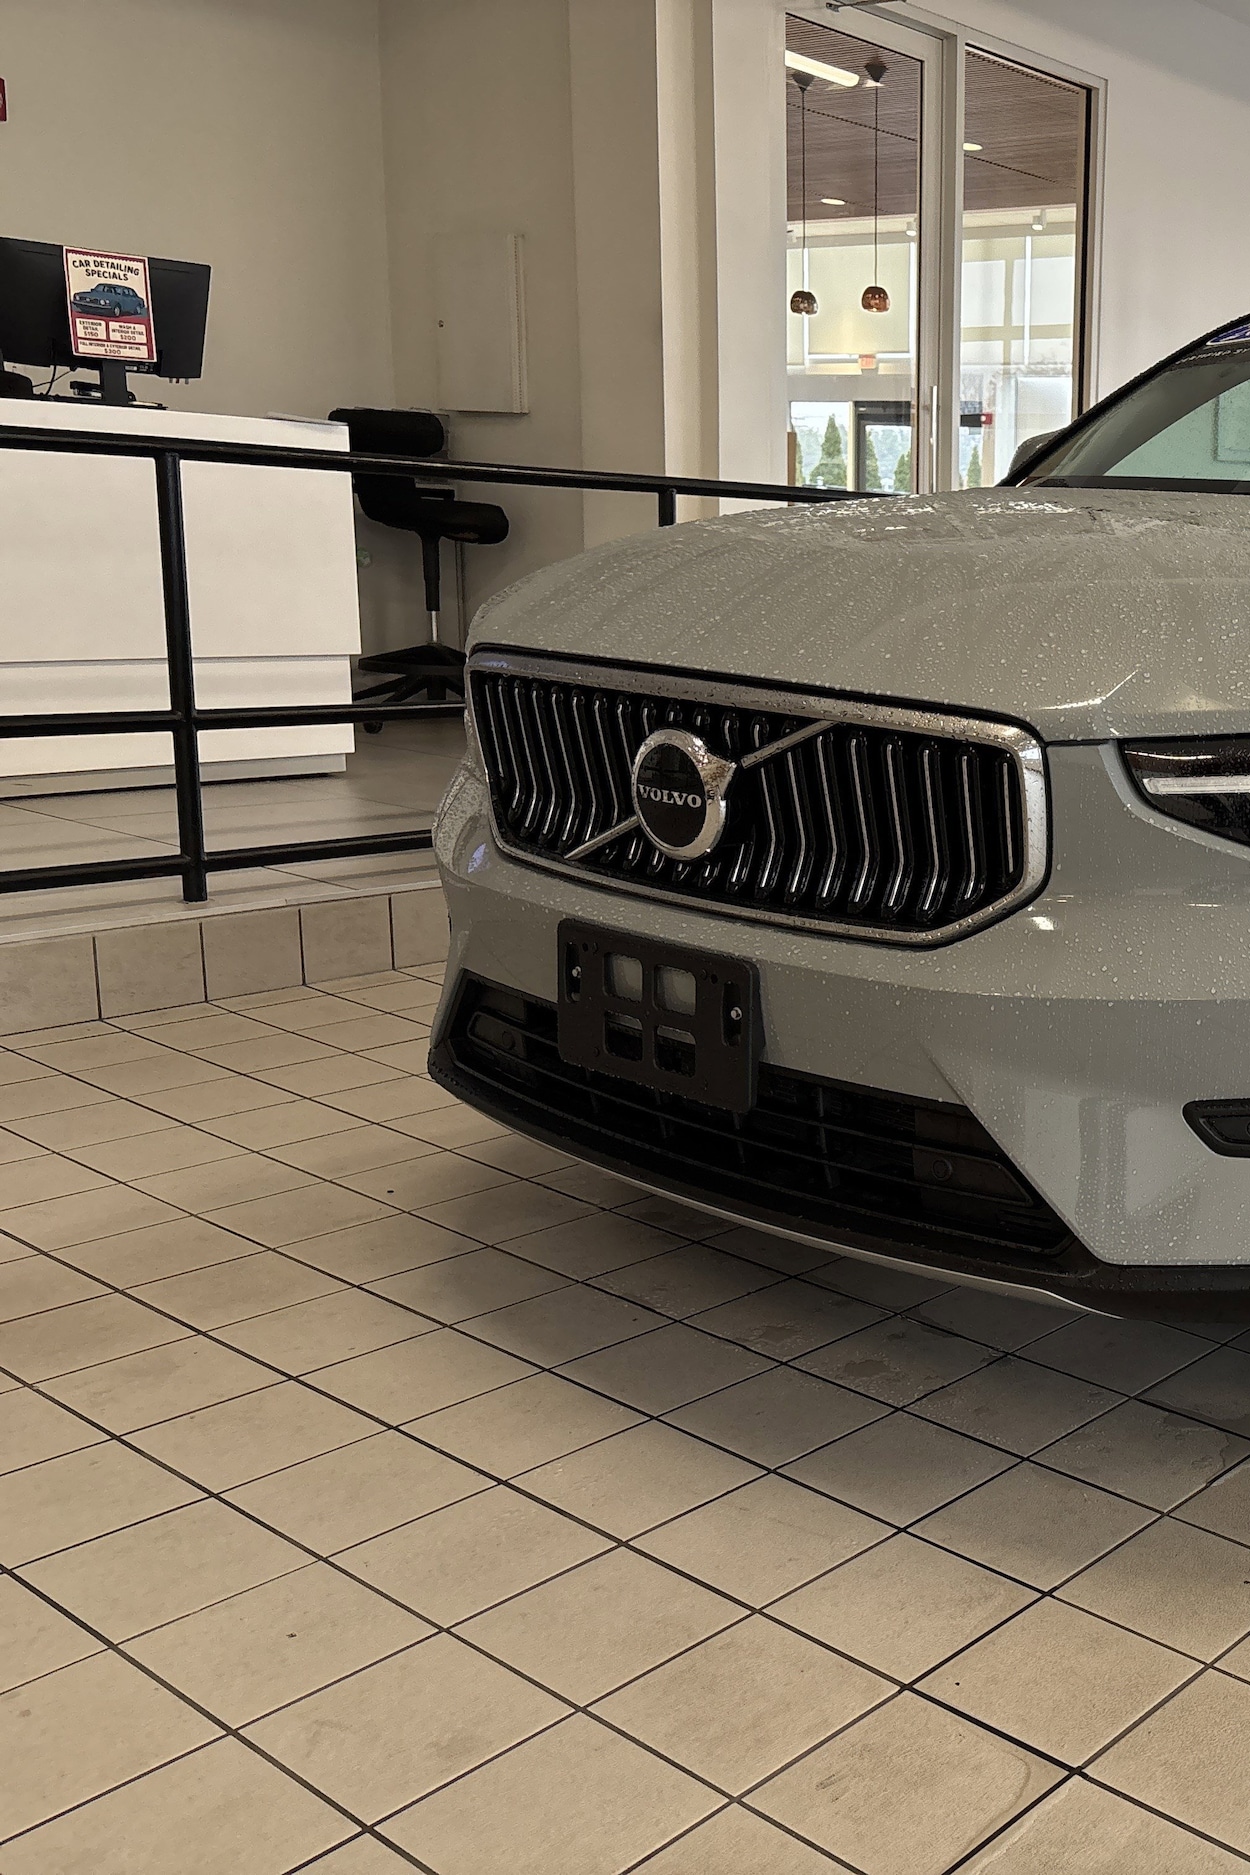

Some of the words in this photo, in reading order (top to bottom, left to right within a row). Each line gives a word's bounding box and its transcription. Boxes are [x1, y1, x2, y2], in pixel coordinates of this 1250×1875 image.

[72, 260, 91, 268] CAR
[93, 260, 140, 276] DETAILING
[85, 268, 129, 281] SPECIALS
[637, 783, 702, 809] VOLVO
